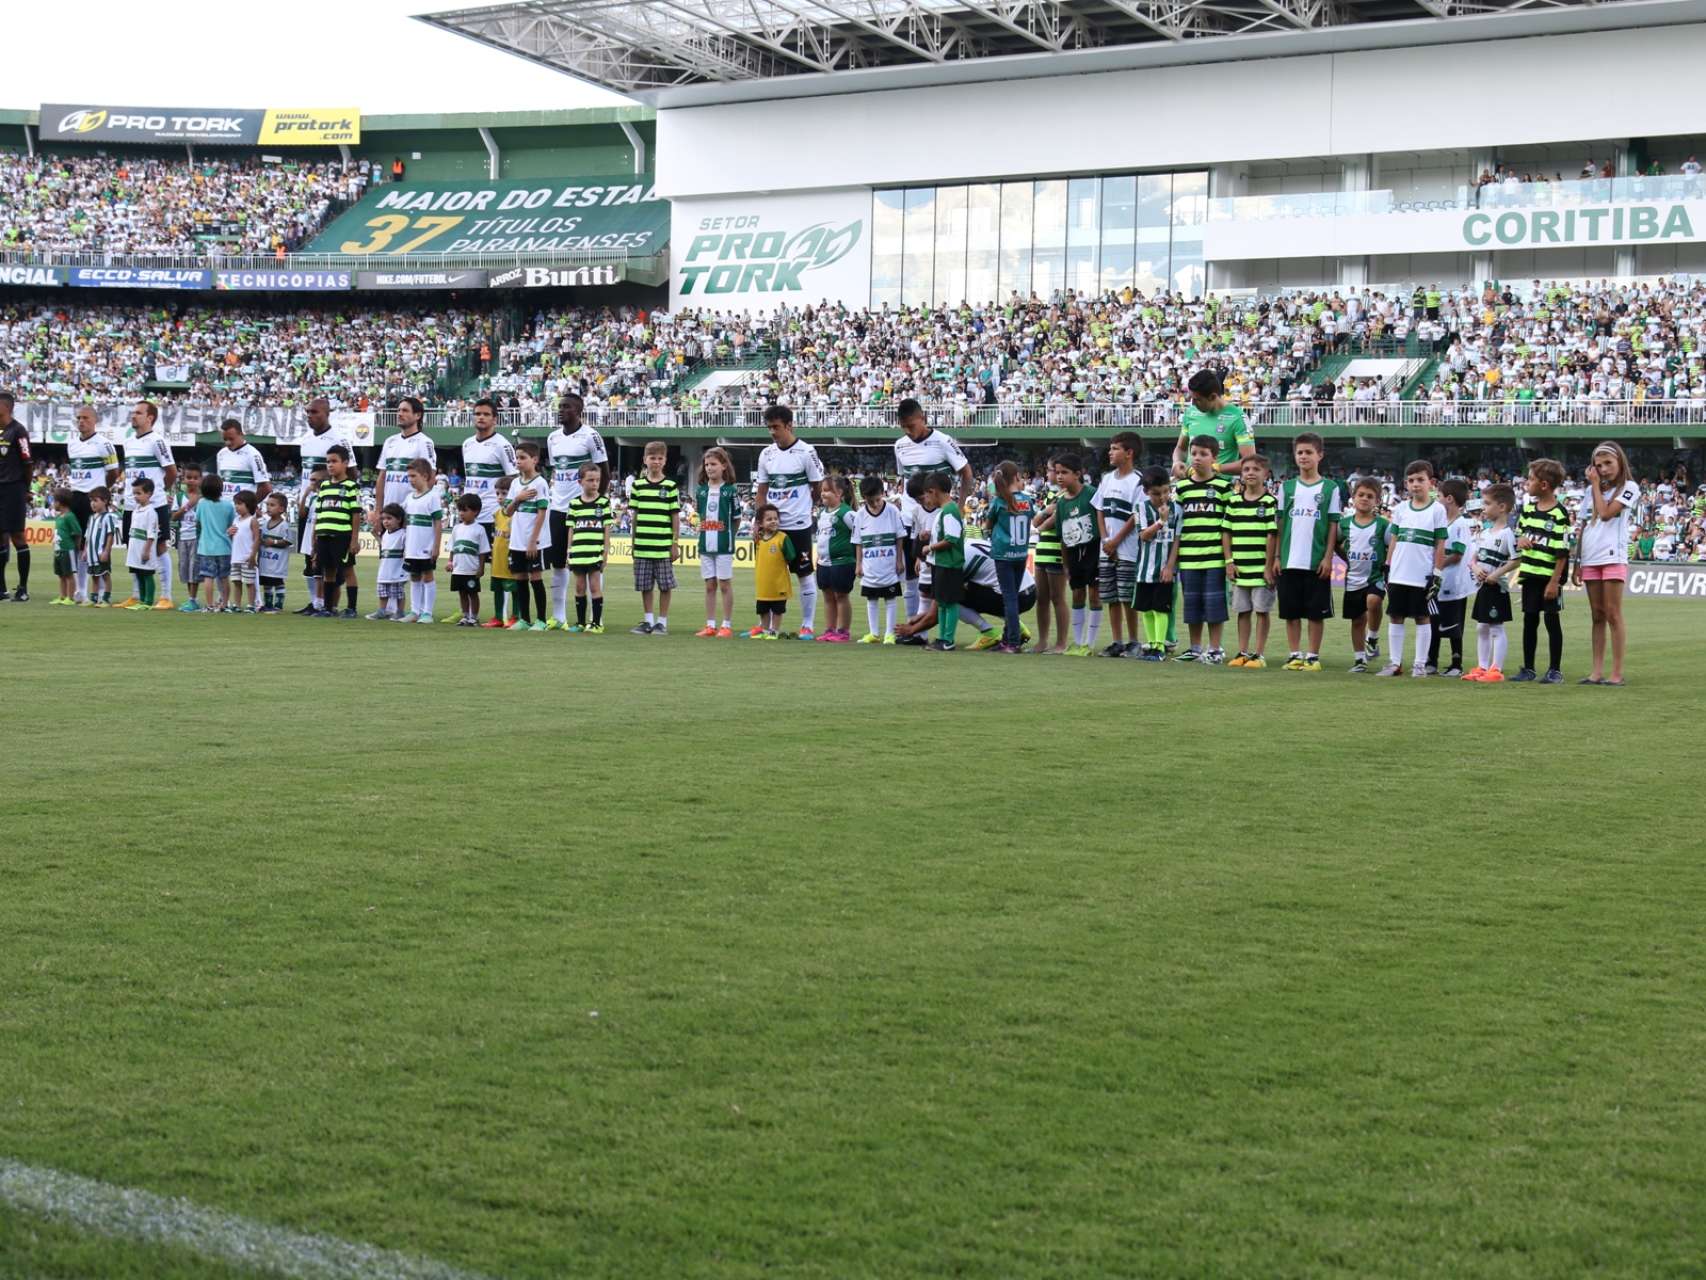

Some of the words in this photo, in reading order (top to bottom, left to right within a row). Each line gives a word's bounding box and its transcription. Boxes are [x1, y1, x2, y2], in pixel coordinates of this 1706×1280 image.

[107, 114, 166, 130] PRO
[171, 116, 245, 132] TORK
[274, 118, 353, 133] protork
[375, 190, 497, 211] MAIOR
[496, 188, 552, 210] DO
[466, 215, 582, 235] TÍTULOS
[699, 215, 760, 230] SETOR
[1462, 205, 1694, 246] CORITIBA
[340, 214, 465, 255] 37
[443, 231, 653, 254] PARANAENSES
[684, 231, 787, 262] PRO
[489, 267, 522, 288] ARROZ
[523, 265, 621, 288] Buriti
[679, 260, 810, 295] TORK
[1289, 508, 1320, 519] CAIXA
[1010, 514, 1028, 546] 10
[864, 549, 894, 559] CAIXA
[1629, 571, 1706, 595] CHEVR
